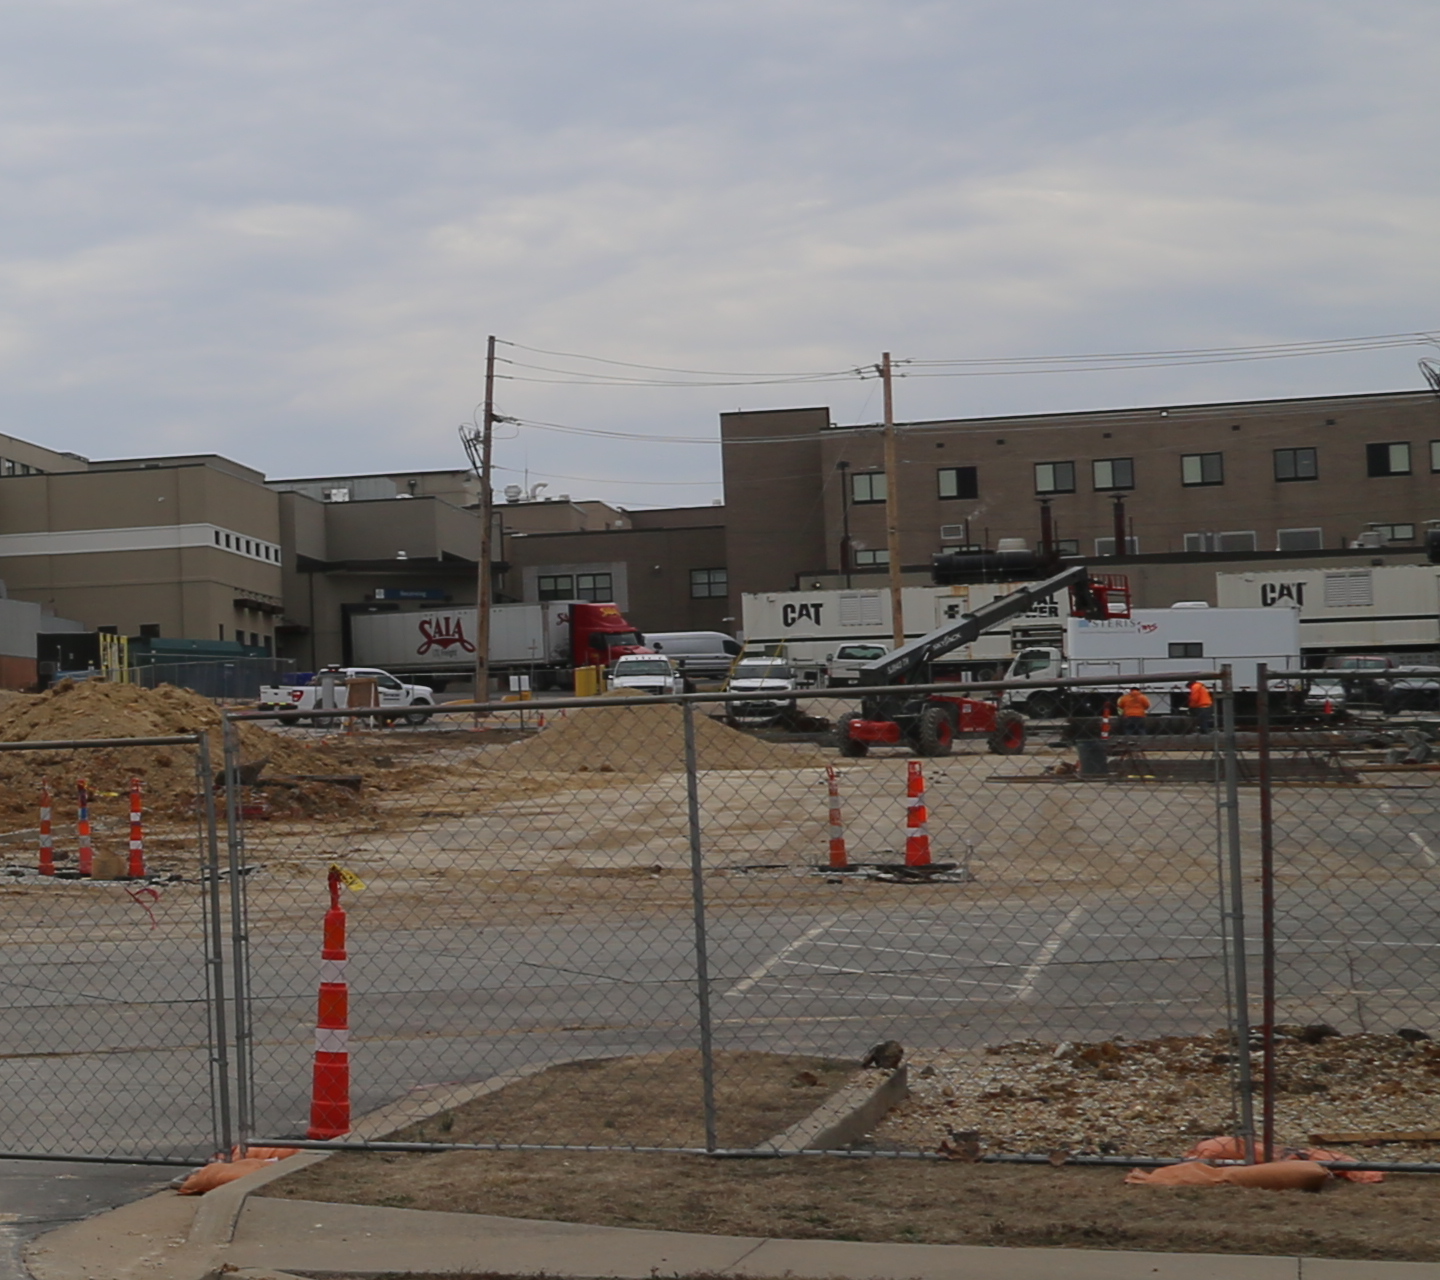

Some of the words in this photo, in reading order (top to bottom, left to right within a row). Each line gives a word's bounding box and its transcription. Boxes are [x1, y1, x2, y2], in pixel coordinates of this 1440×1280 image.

[1261, 582, 1307, 607] CAT
[782, 603, 823, 628] CAT
[417, 616, 476, 655] SAIA
